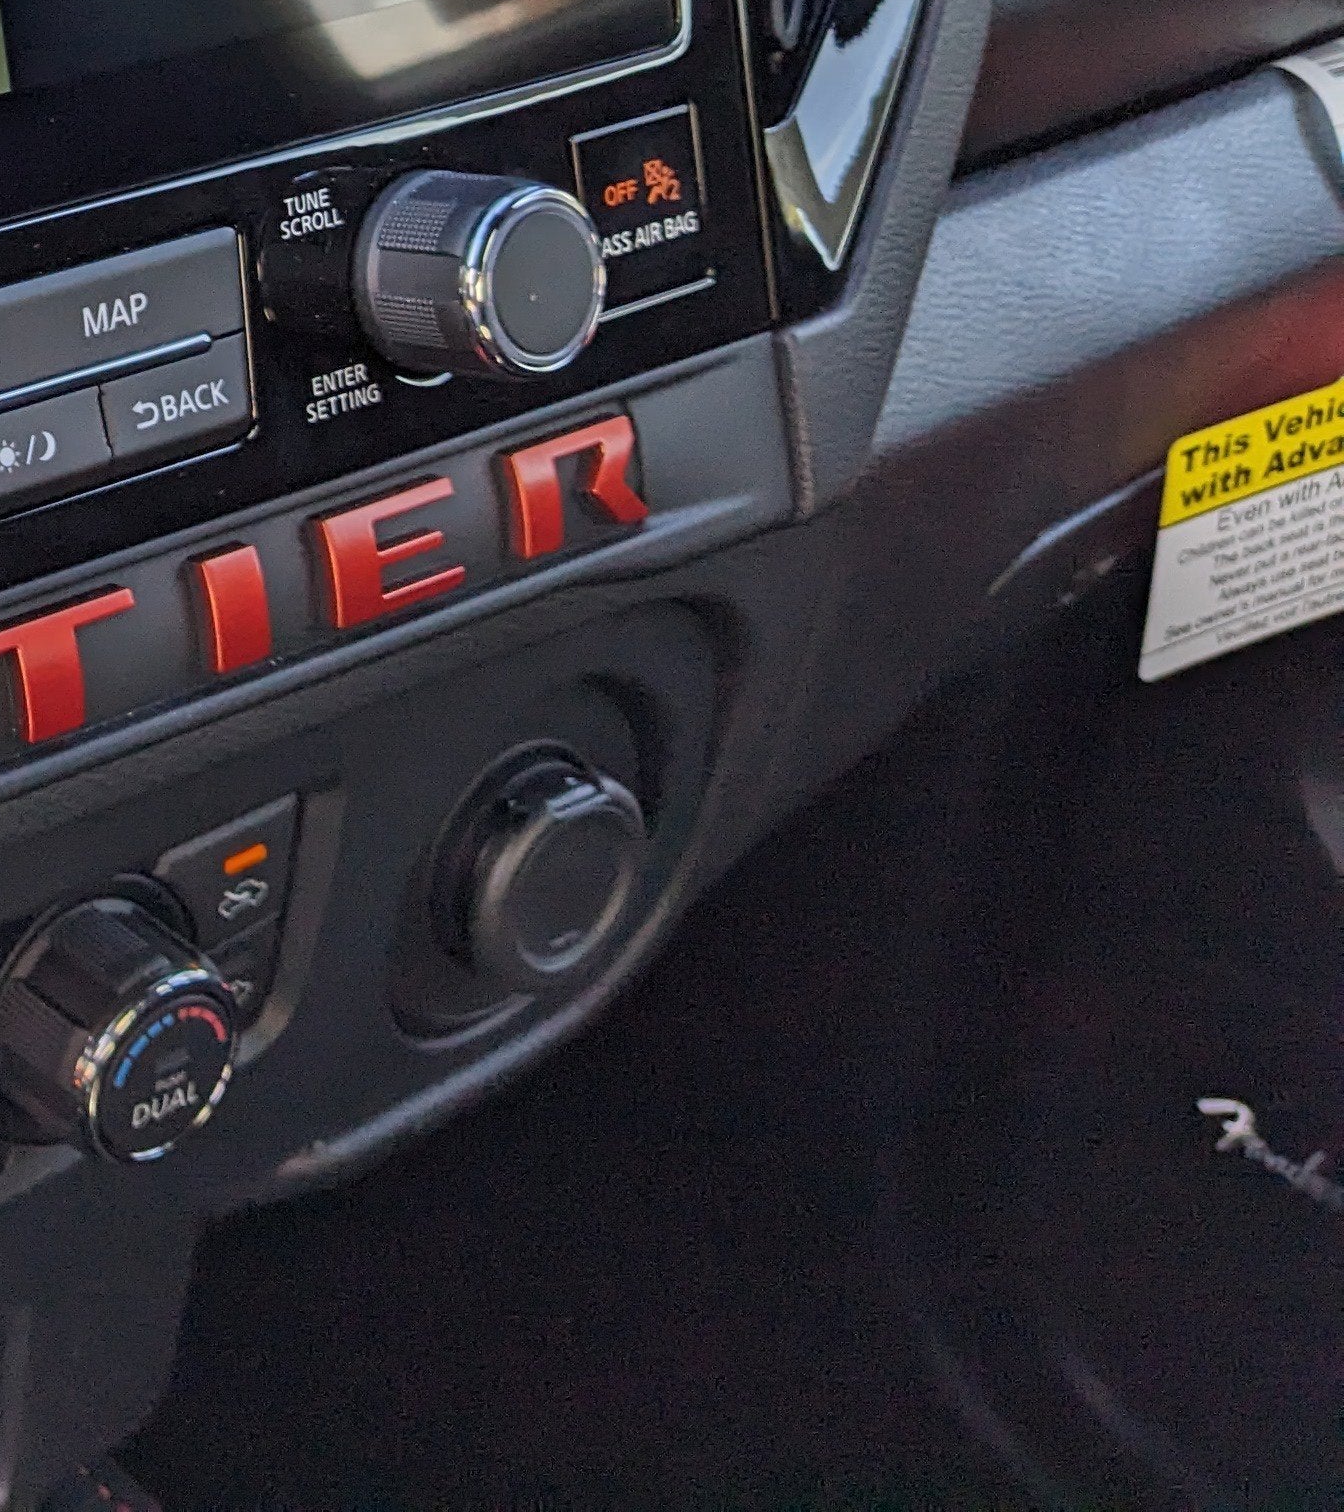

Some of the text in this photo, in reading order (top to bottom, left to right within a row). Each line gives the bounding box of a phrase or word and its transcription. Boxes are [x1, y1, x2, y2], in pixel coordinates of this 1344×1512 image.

[282, 187, 331, 217] TUNE
[603, 178, 640, 207] OFF
[279, 207, 344, 240] SCROLL
[601, 210, 701, 258] ASS AIR BAG
[82, 292, 149, 338] MAP
[160, 378, 230, 422] BACK
[311, 363, 368, 397] ENTER
[305, 383, 382, 424] SETTING
[1180, 432, 1251, 473] This
[1180, 464, 1253, 508] with
[132, 1080, 200, 1128] DUAL
